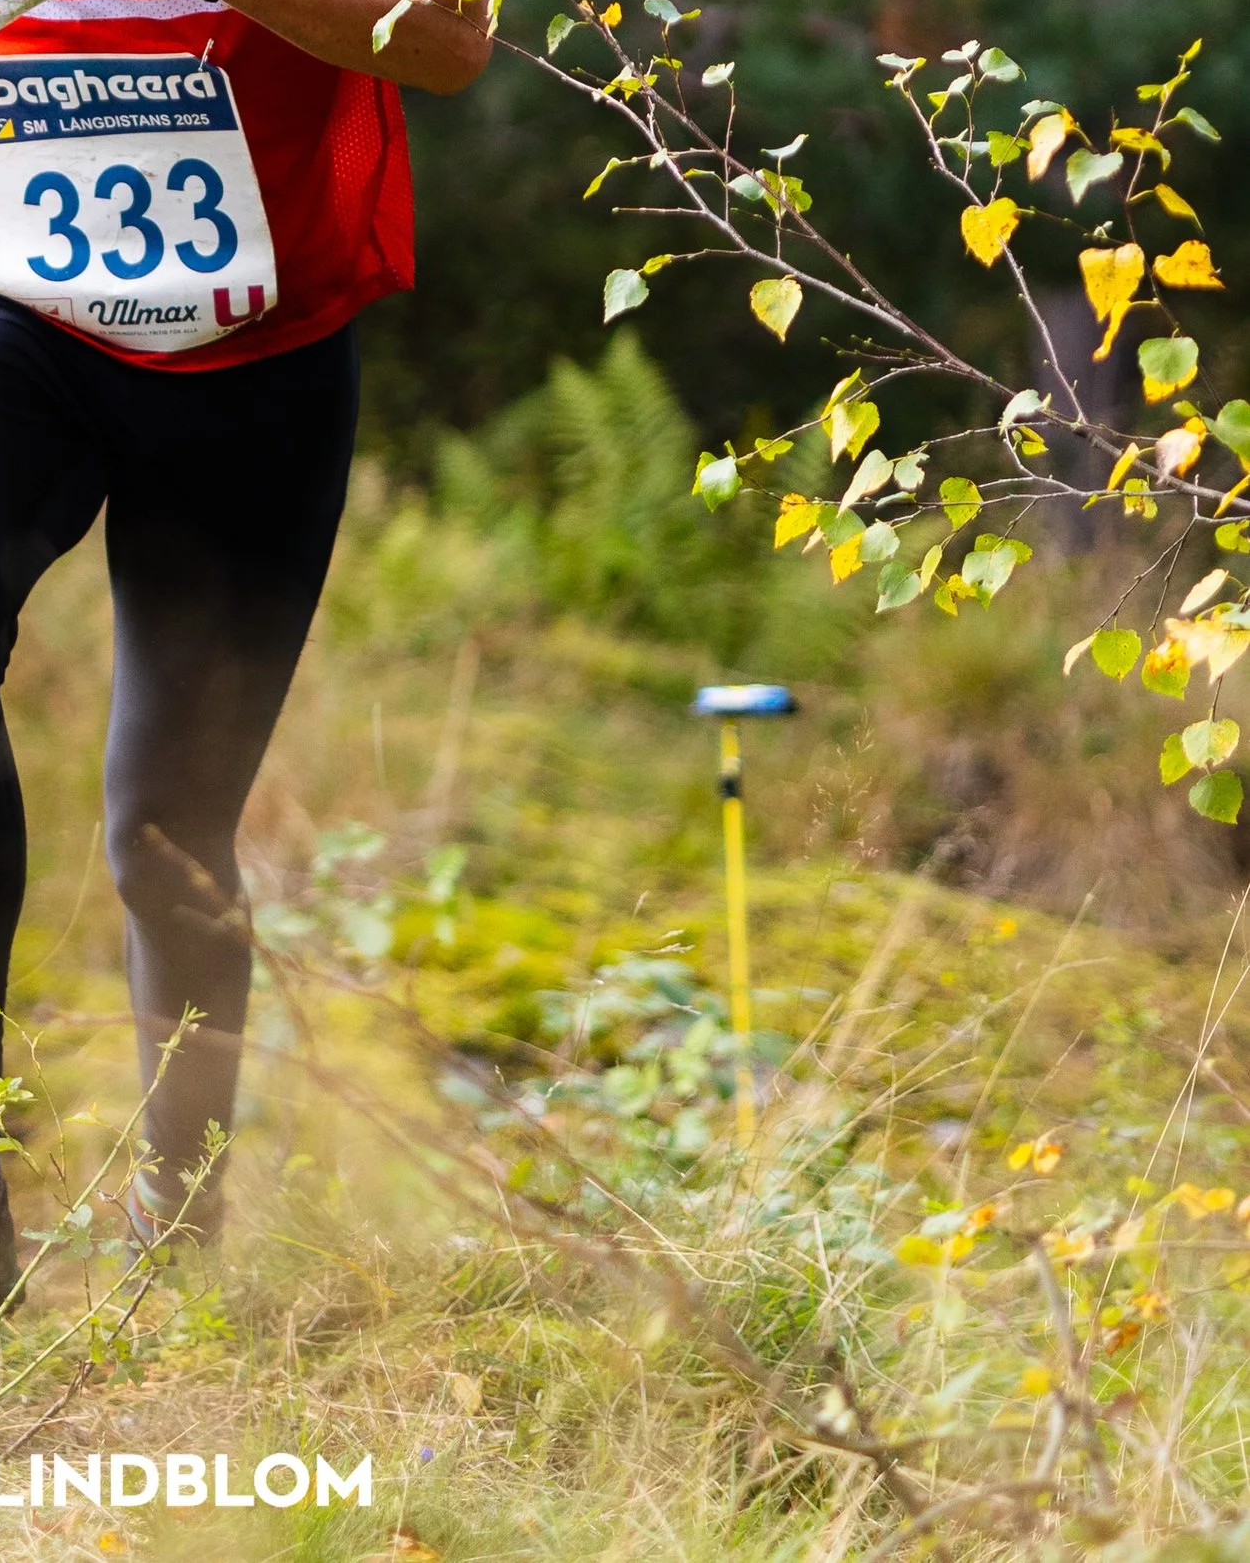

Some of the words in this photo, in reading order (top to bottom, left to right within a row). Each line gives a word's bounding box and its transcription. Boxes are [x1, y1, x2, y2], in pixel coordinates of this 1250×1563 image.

[23, 119, 48, 135] SM
[59, 113, 171, 133] LÅNGDISTANS
[176, 113, 210, 126] 2025
[23, 157, 239, 282] 333
[88, 298, 198, 326] Ullmax
